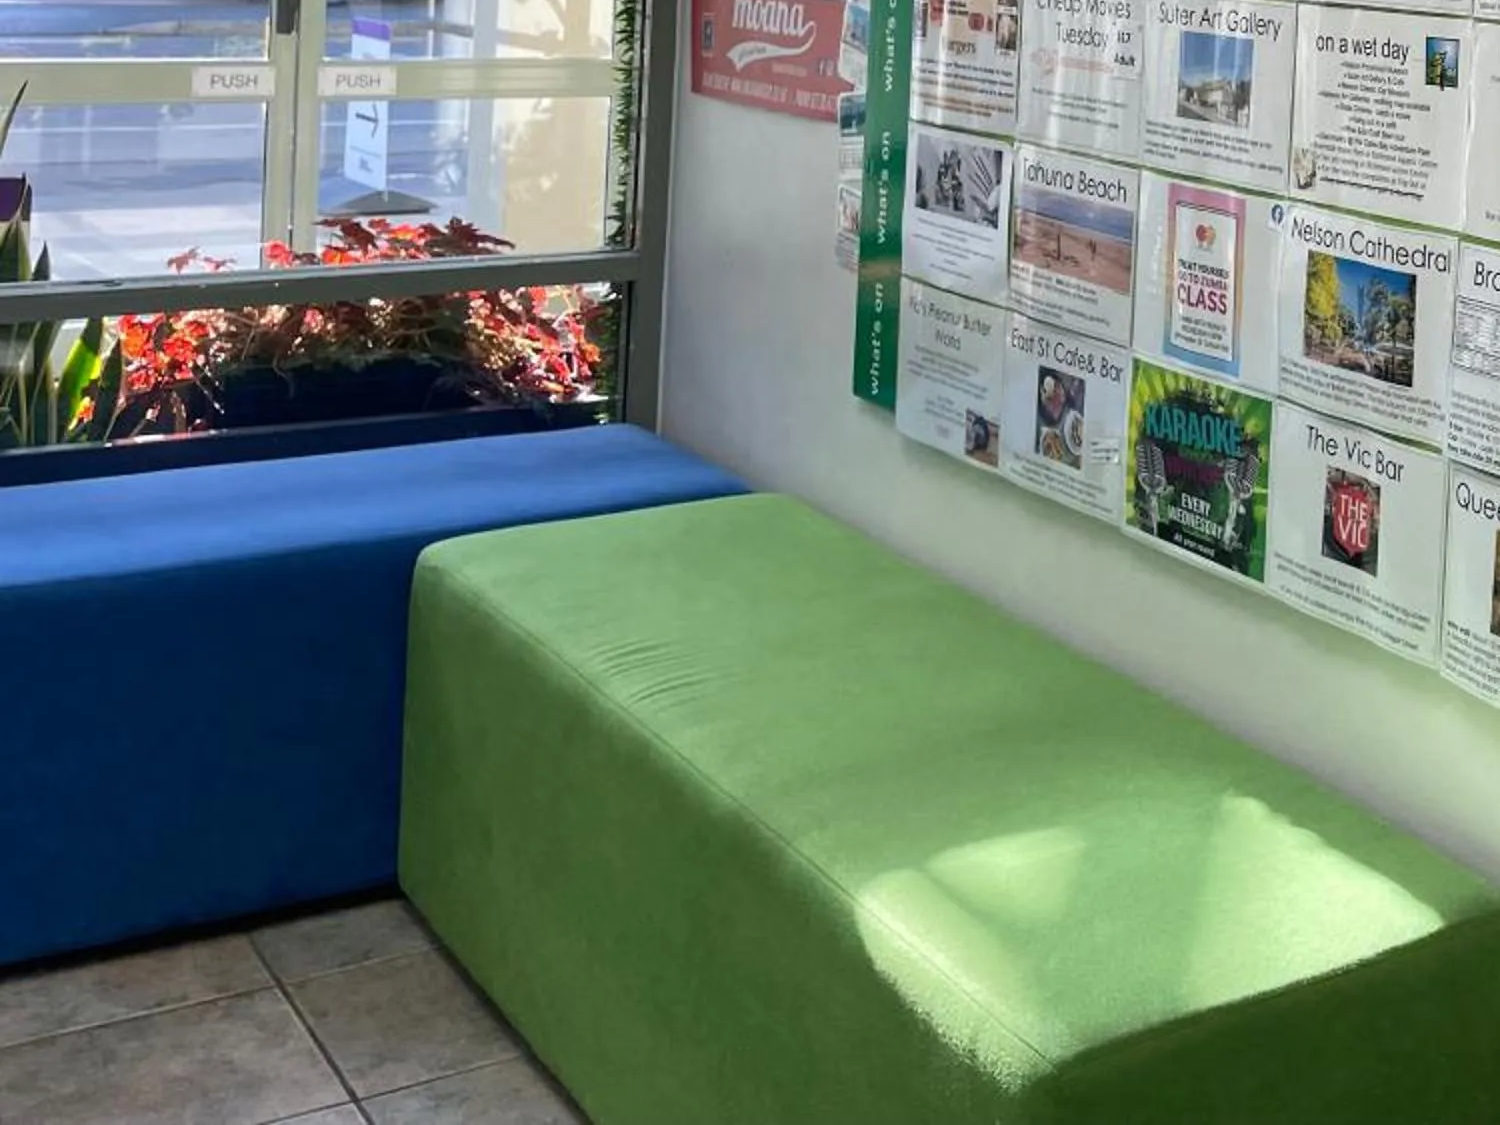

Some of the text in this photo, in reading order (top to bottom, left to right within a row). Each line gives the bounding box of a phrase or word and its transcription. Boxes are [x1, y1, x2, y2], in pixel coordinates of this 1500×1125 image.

[1159, 1, 1282, 42] Suter Art Gallery
[884, 11, 896, 92] what's
[1316, 35, 1409, 65] on a wet day
[210, 74, 258, 89] PUSH
[335, 74, 381, 88] PUSH
[877, 130, 890, 244] what's on
[1078, 170, 1127, 203] Beach
[1291, 217, 1345, 250] Nelson
[1350, 231, 1451, 274] Cathedral
[1177, 283, 1227, 315] CLASS
[871, 282, 883, 396] what's on
[1144, 402, 1243, 459] KARAOKE
[1306, 425, 1404, 482] The Vic Bar
[1181, 492, 1211, 516] EVERY
[1340, 495, 1368, 521] THE
[1338, 516, 1369, 548] VIC
